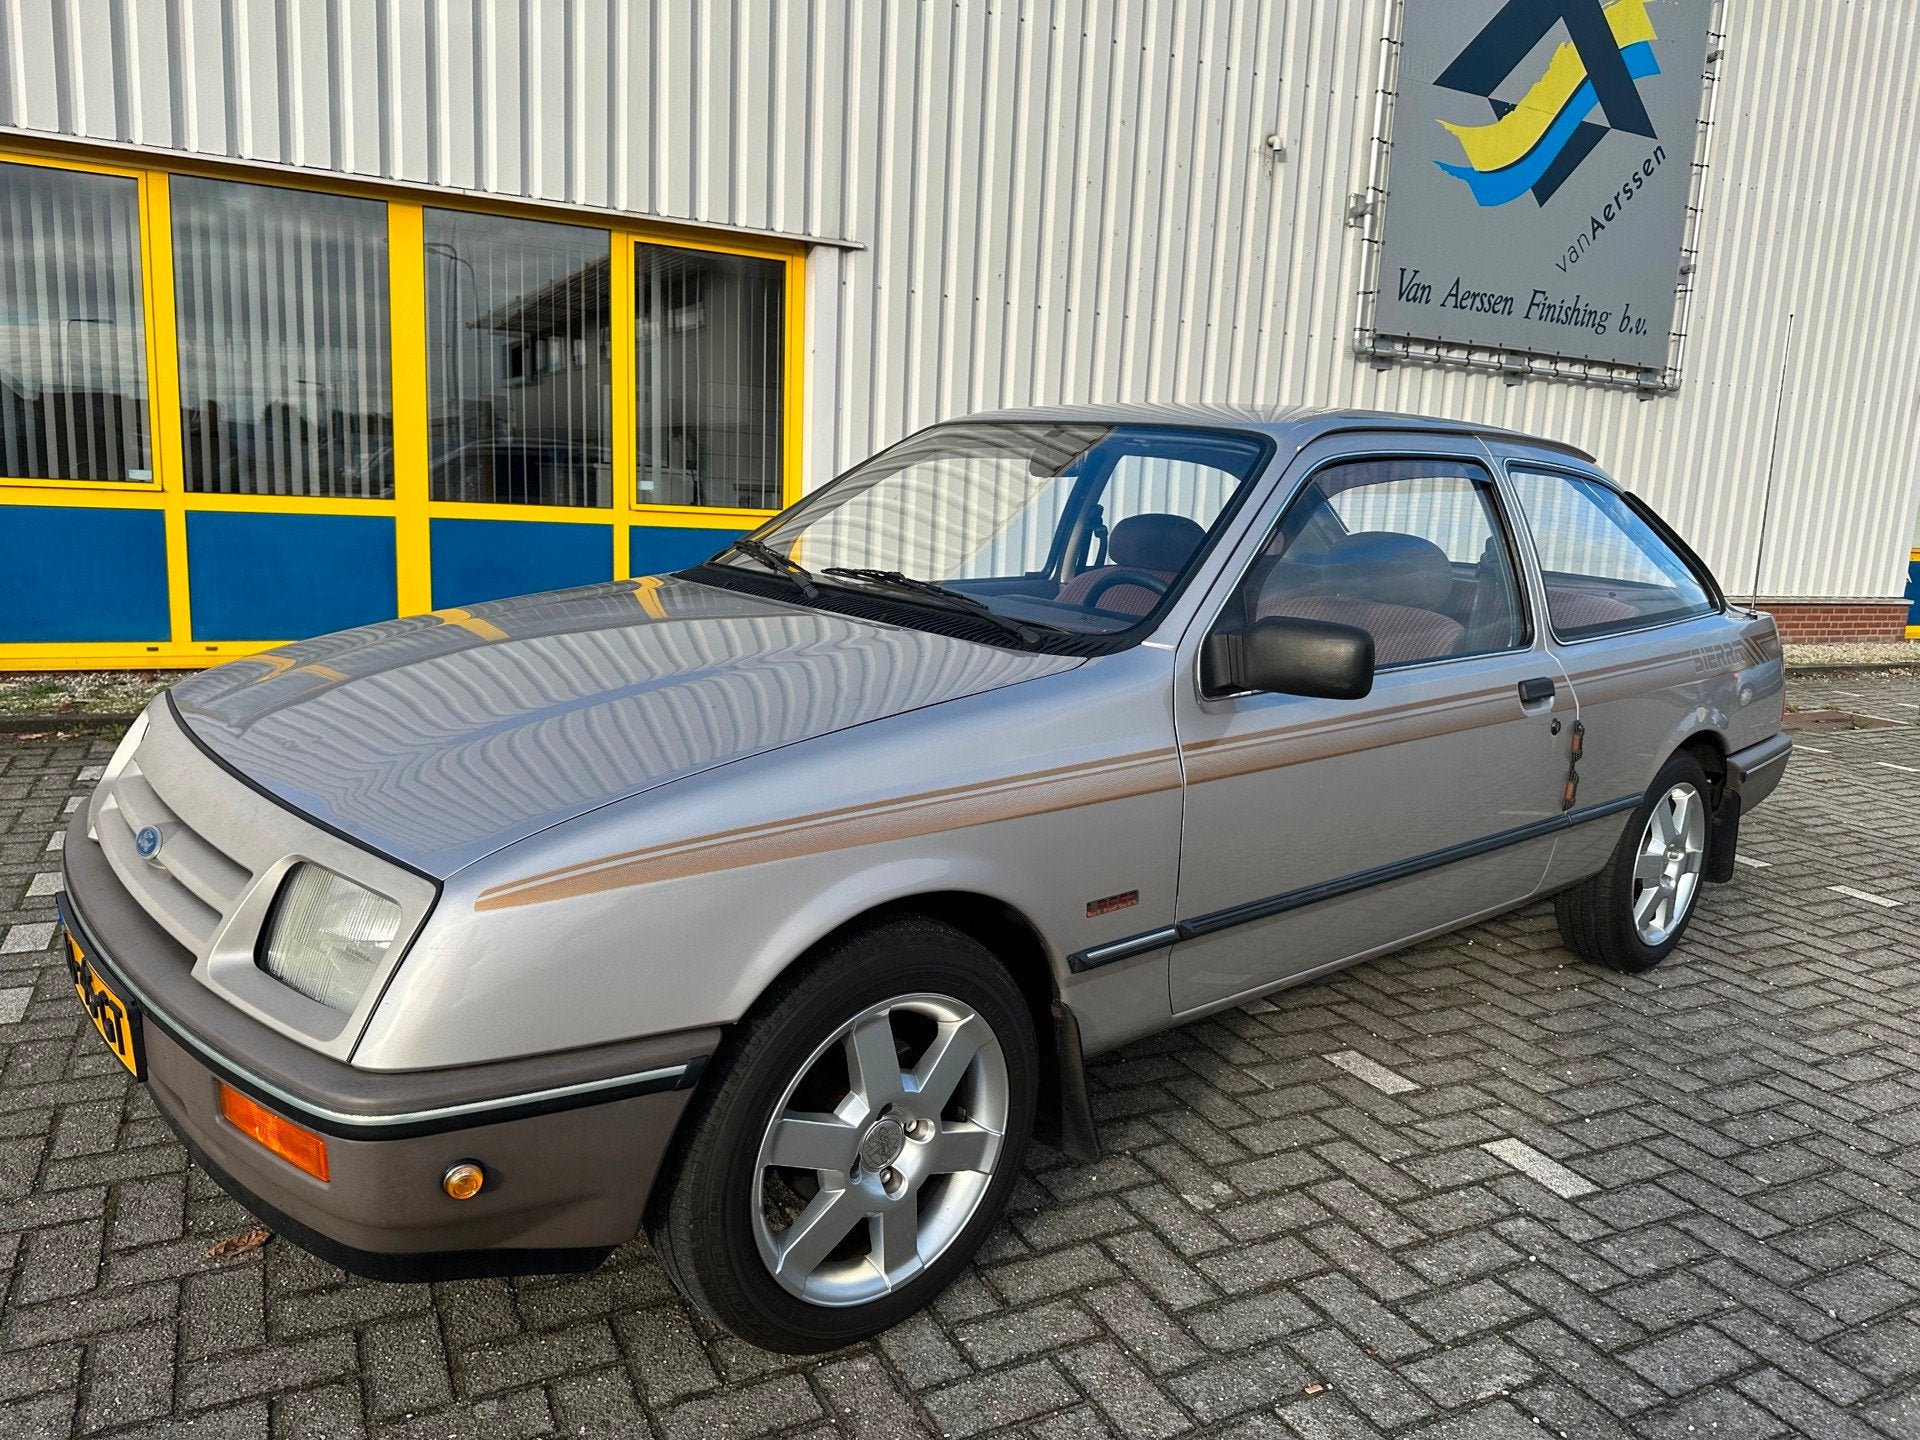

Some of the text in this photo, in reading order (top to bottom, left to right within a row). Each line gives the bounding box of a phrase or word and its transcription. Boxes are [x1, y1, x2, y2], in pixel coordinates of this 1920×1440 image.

[1397, 267, 1648, 336] Van Aerssen Finishing b.v.
